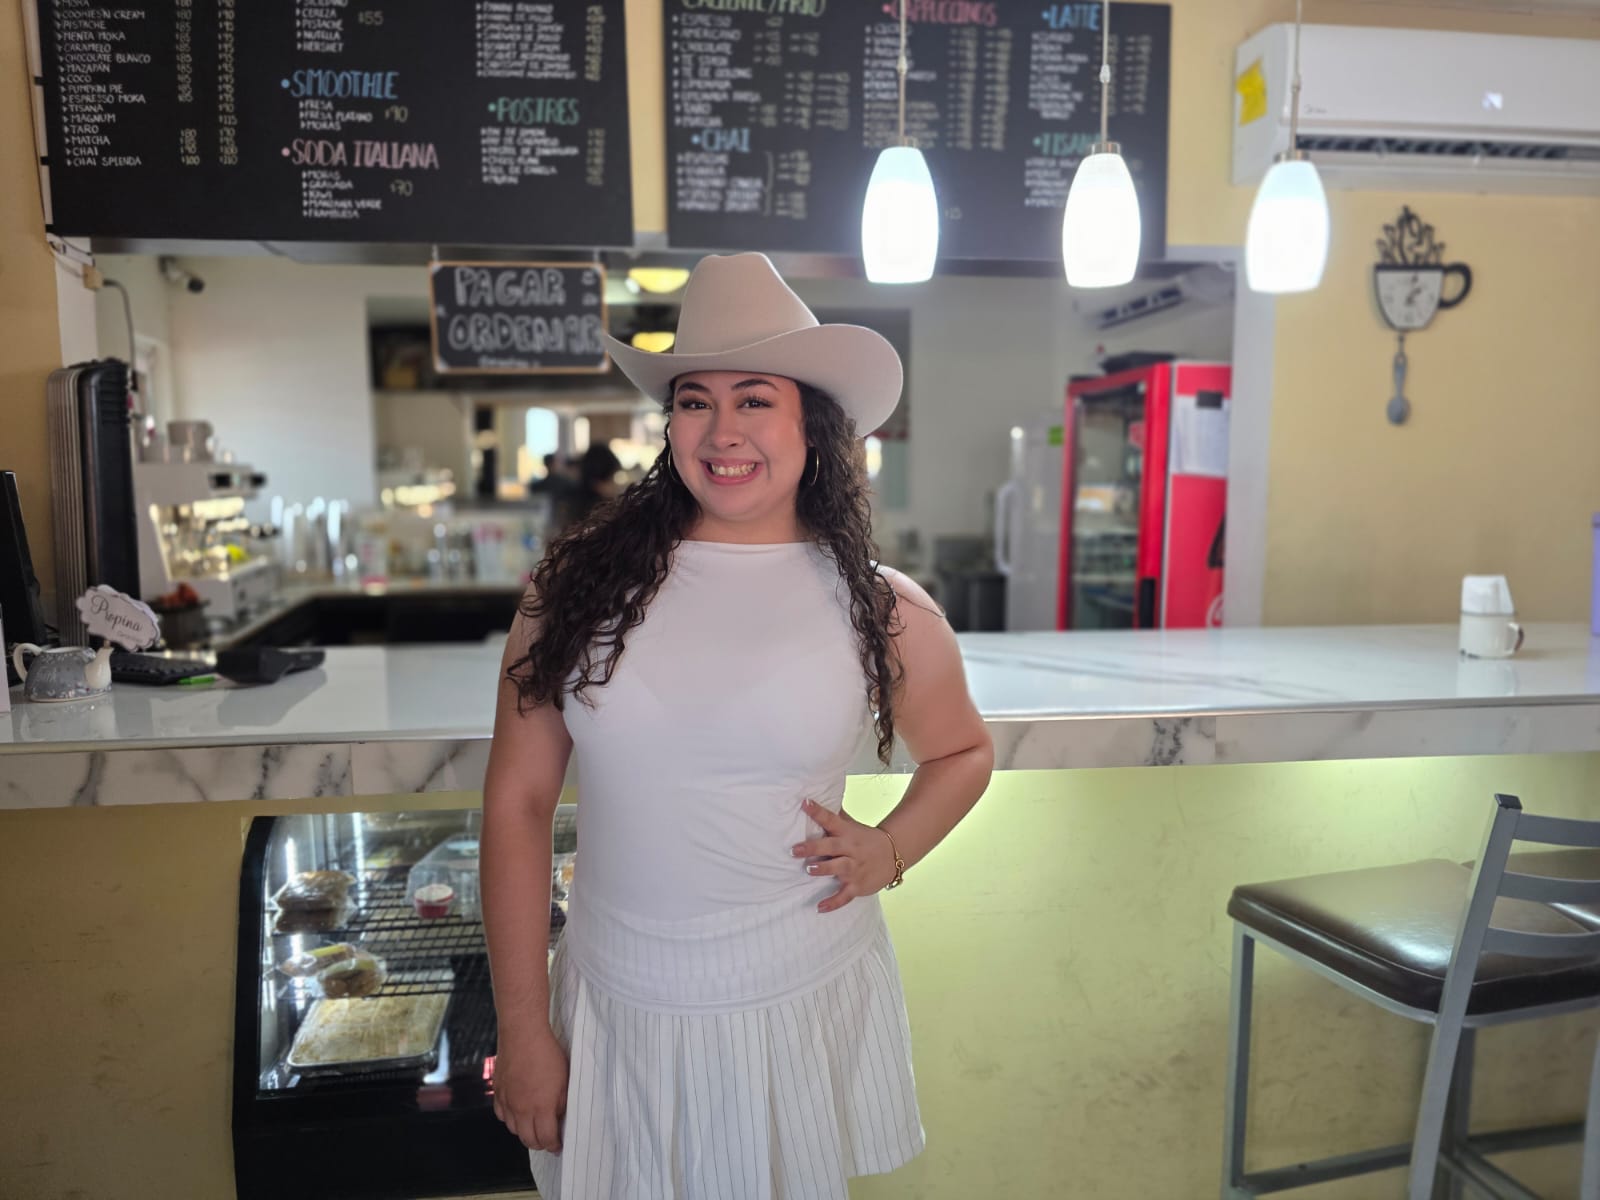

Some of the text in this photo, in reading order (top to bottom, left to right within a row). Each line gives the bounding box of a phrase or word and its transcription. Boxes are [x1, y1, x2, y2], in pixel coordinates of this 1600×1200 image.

[113, 10, 145, 20] CREAM
[1048, 3, 1102, 32] LATTE
[63, 20, 107, 30] PISTACHE
[63, 31, 126, 42] MENTA MOKA
[63, 42, 112, 53] CARAMELO
[64, 53, 151, 64] CHOCOLATE BLANCO
[66, 74, 93, 83] COCO
[68, 83, 124, 94] PUMPKIN PIE
[290, 70, 399, 99] SMOOTHIE
[68, 94, 146, 104] ESPRESSO MOKA
[68, 104, 104, 113] TISANA
[497, 96, 580, 125] POSTRES
[71, 113, 117, 124] MAGNUM
[70, 124, 100, 134] TARO
[71, 135, 111, 146] MATCHA
[700, 127, 751, 154] CHAI
[72, 146, 99, 157] CHAI
[291, 138, 439, 170] SODA ITALIANA
[101, 156, 142, 167] SPLENDA
[453, 266, 568, 309] PAGAR
[447, 312, 605, 356] ORDENAR
[90, 594, 144, 631] Propina
